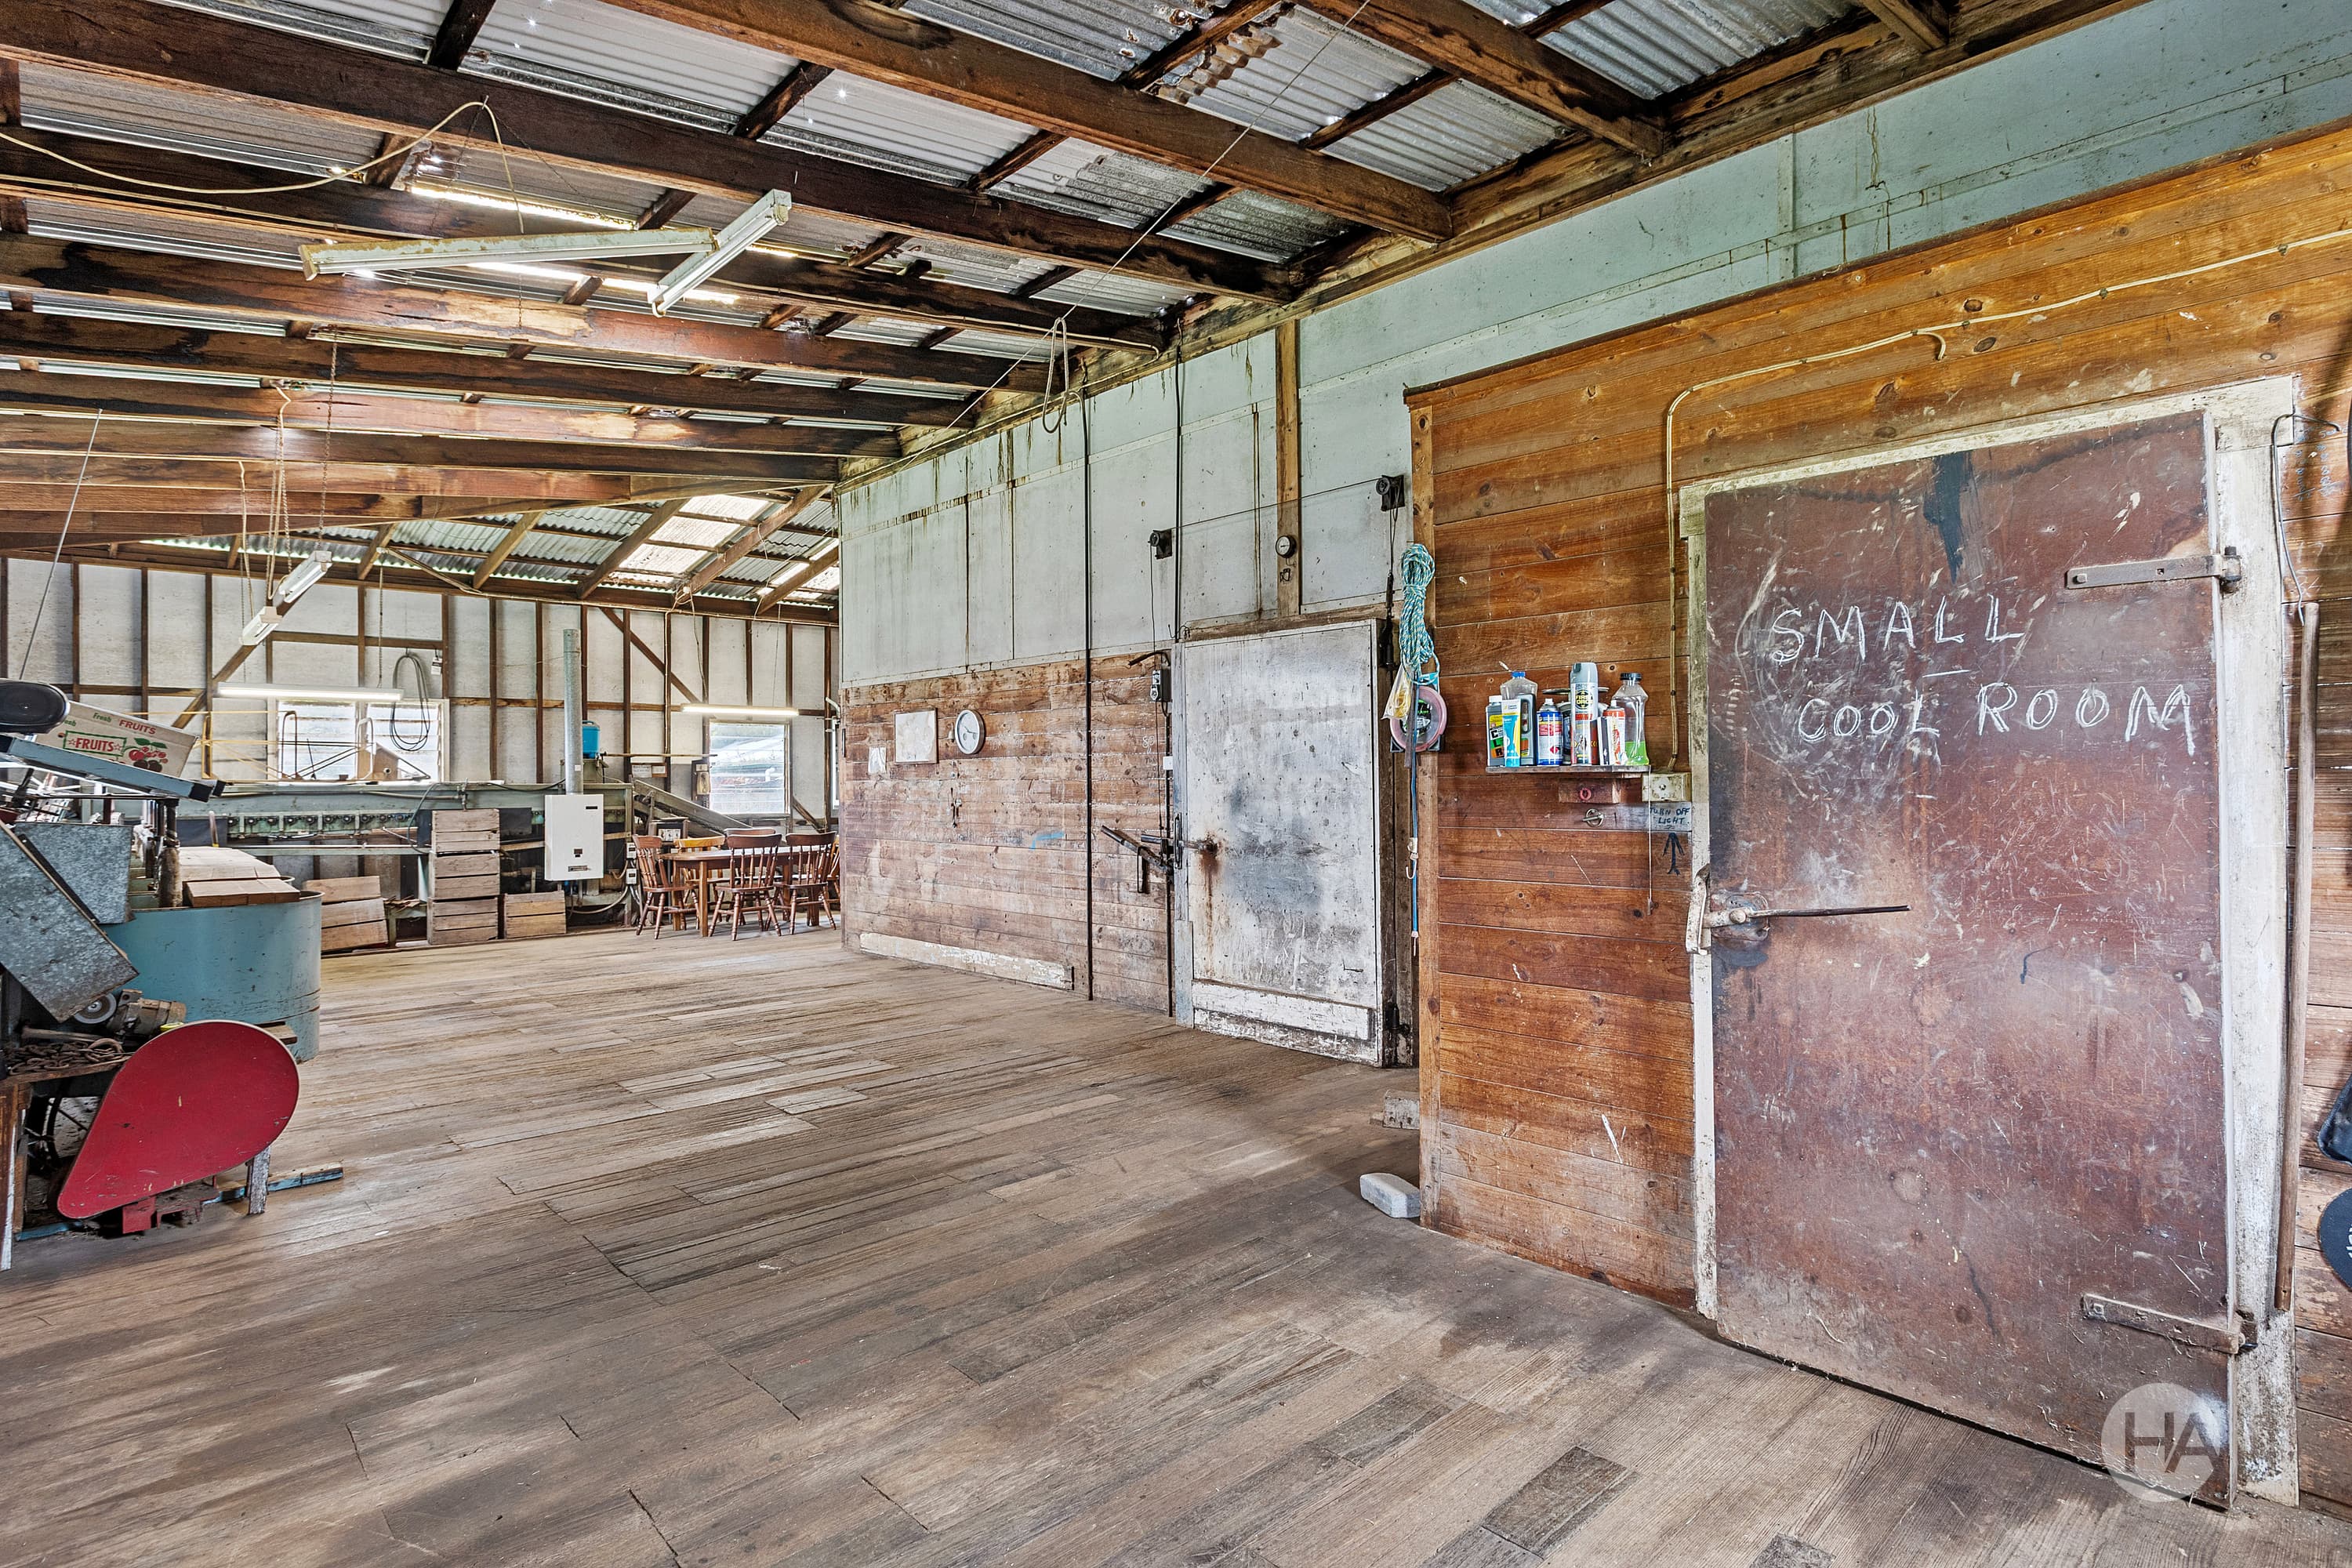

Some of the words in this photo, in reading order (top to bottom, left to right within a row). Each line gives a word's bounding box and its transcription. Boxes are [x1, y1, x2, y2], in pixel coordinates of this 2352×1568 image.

[1771, 593, 2025, 665] SMALL
[63, 718, 77, 728] esh
[93, 712, 112, 723] Fresh
[1798, 686, 1940, 743] COOL
[1976, 681, 2196, 757] ROOM
[118, 719, 157, 735] FRUITS
[74, 737, 114, 753] FRUITS
[1650, 807, 1671, 816] TURN
[1675, 807, 1691, 816] OFF
